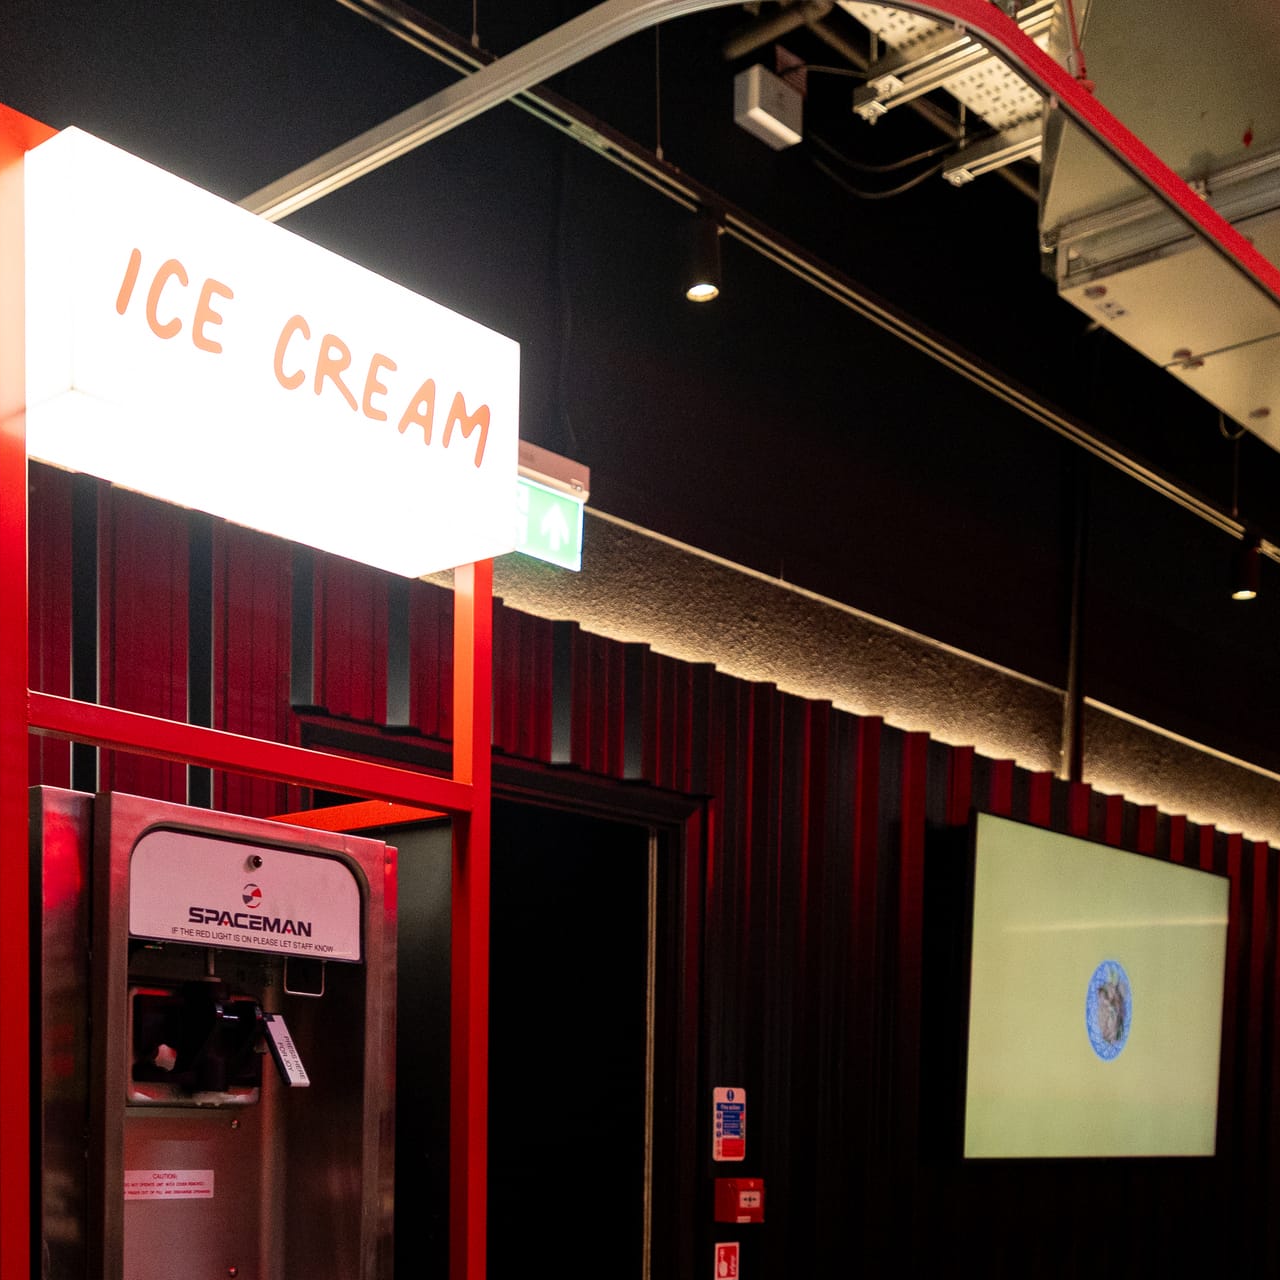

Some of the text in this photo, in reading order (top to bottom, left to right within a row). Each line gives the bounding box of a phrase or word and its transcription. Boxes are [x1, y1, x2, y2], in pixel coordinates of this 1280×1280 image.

[115, 246, 492, 469] ICE CREAM
[188, 906, 312, 938] SPACEMAN
[171, 927, 334, 953] IF THE RED LIGHT IS ON PLEASE LET STAFF KNOW
[284, 1035, 298, 1060] PRESS
